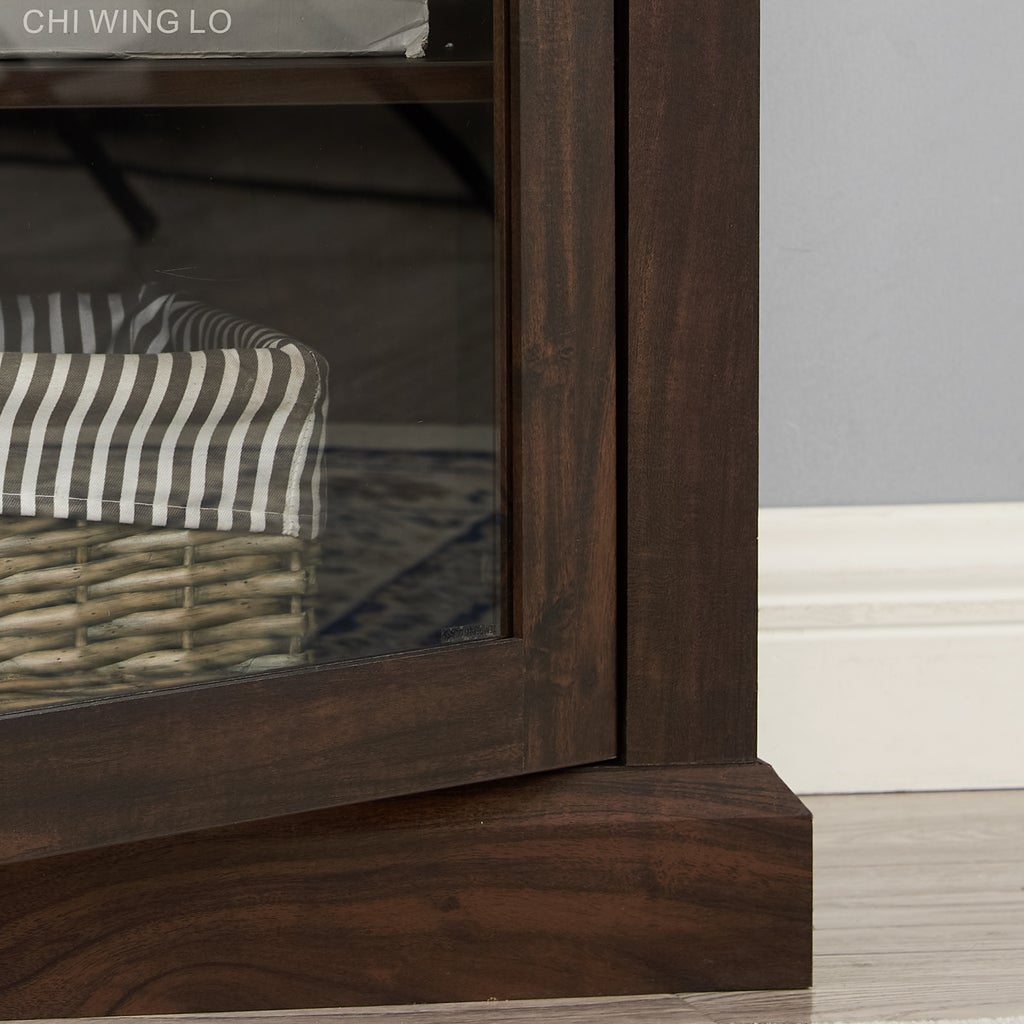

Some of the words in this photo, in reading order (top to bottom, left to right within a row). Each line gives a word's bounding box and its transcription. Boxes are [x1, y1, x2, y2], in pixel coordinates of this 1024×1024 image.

[23, 9, 78, 34] CHI
[89, 9, 179, 34] WING
[190, 9, 232, 34] LO
